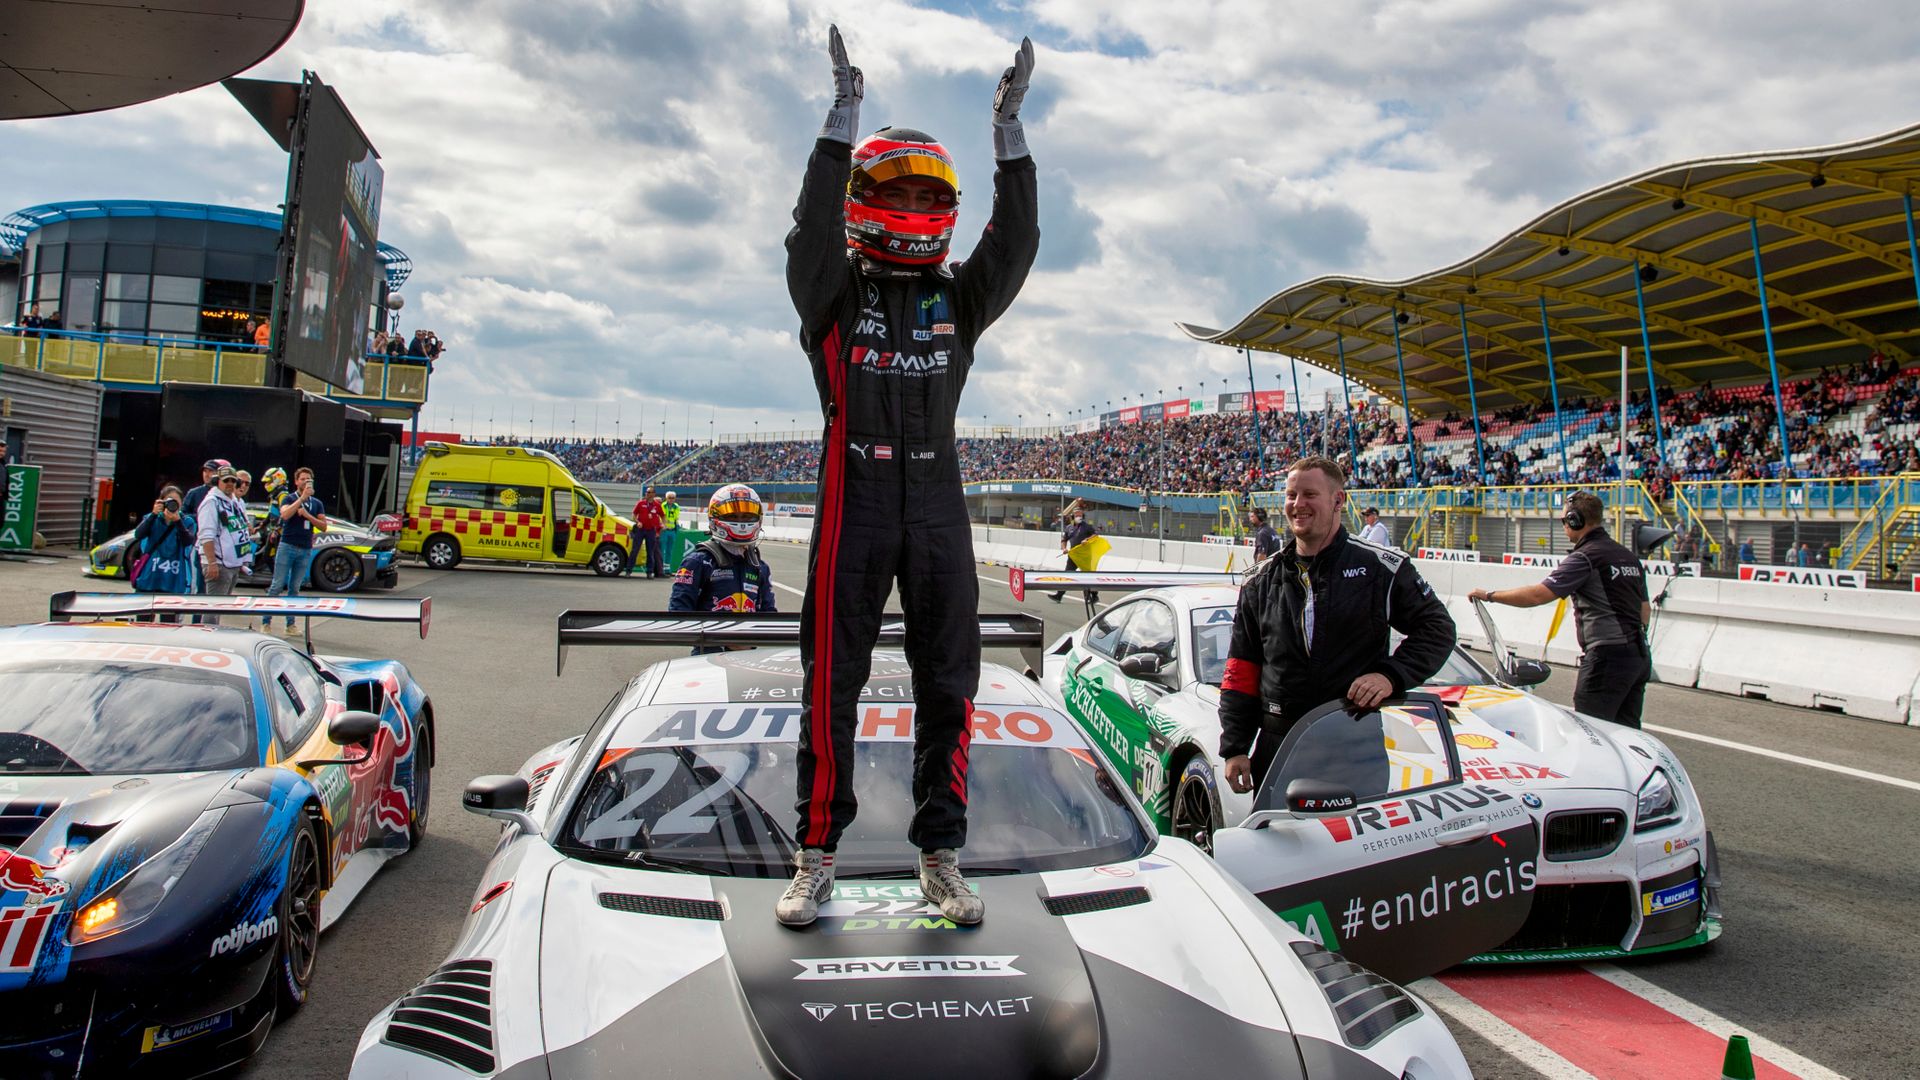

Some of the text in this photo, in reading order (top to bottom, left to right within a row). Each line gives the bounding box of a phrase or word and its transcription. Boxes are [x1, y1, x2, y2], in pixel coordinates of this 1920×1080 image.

[888, 240, 941, 252] RMUS
[863, 349, 948, 371] REMUS
[4, 470, 25, 522] DEKRA
[315, 534, 355, 545] MUS
[478, 538, 541, 550] AMBULANCE
[1823, 592, 1829, 601] 2
[1071, 684, 1130, 765] SCHAEFFLER
[581, 751, 751, 842] 22
[1351, 784, 1514, 836] REMUS
[1363, 826, 1438, 853] PERFORMANCE
[1479, 804, 1526, 823] EXHAUST
[1341, 857, 1538, 939] #endracis
[1663, 887, 1695, 905] MICHELIN
[855, 900, 930, 916] 22
[842, 918, 958, 931] DTM
[209, 915, 278, 959] rotiform
[1503, 949, 1627, 961] Walkenhorst
[817, 960, 1001, 974] RAVENOL
[844, 996, 1033, 1021] TECHEMET
[172, 1016, 221, 1039] MICHELIN
